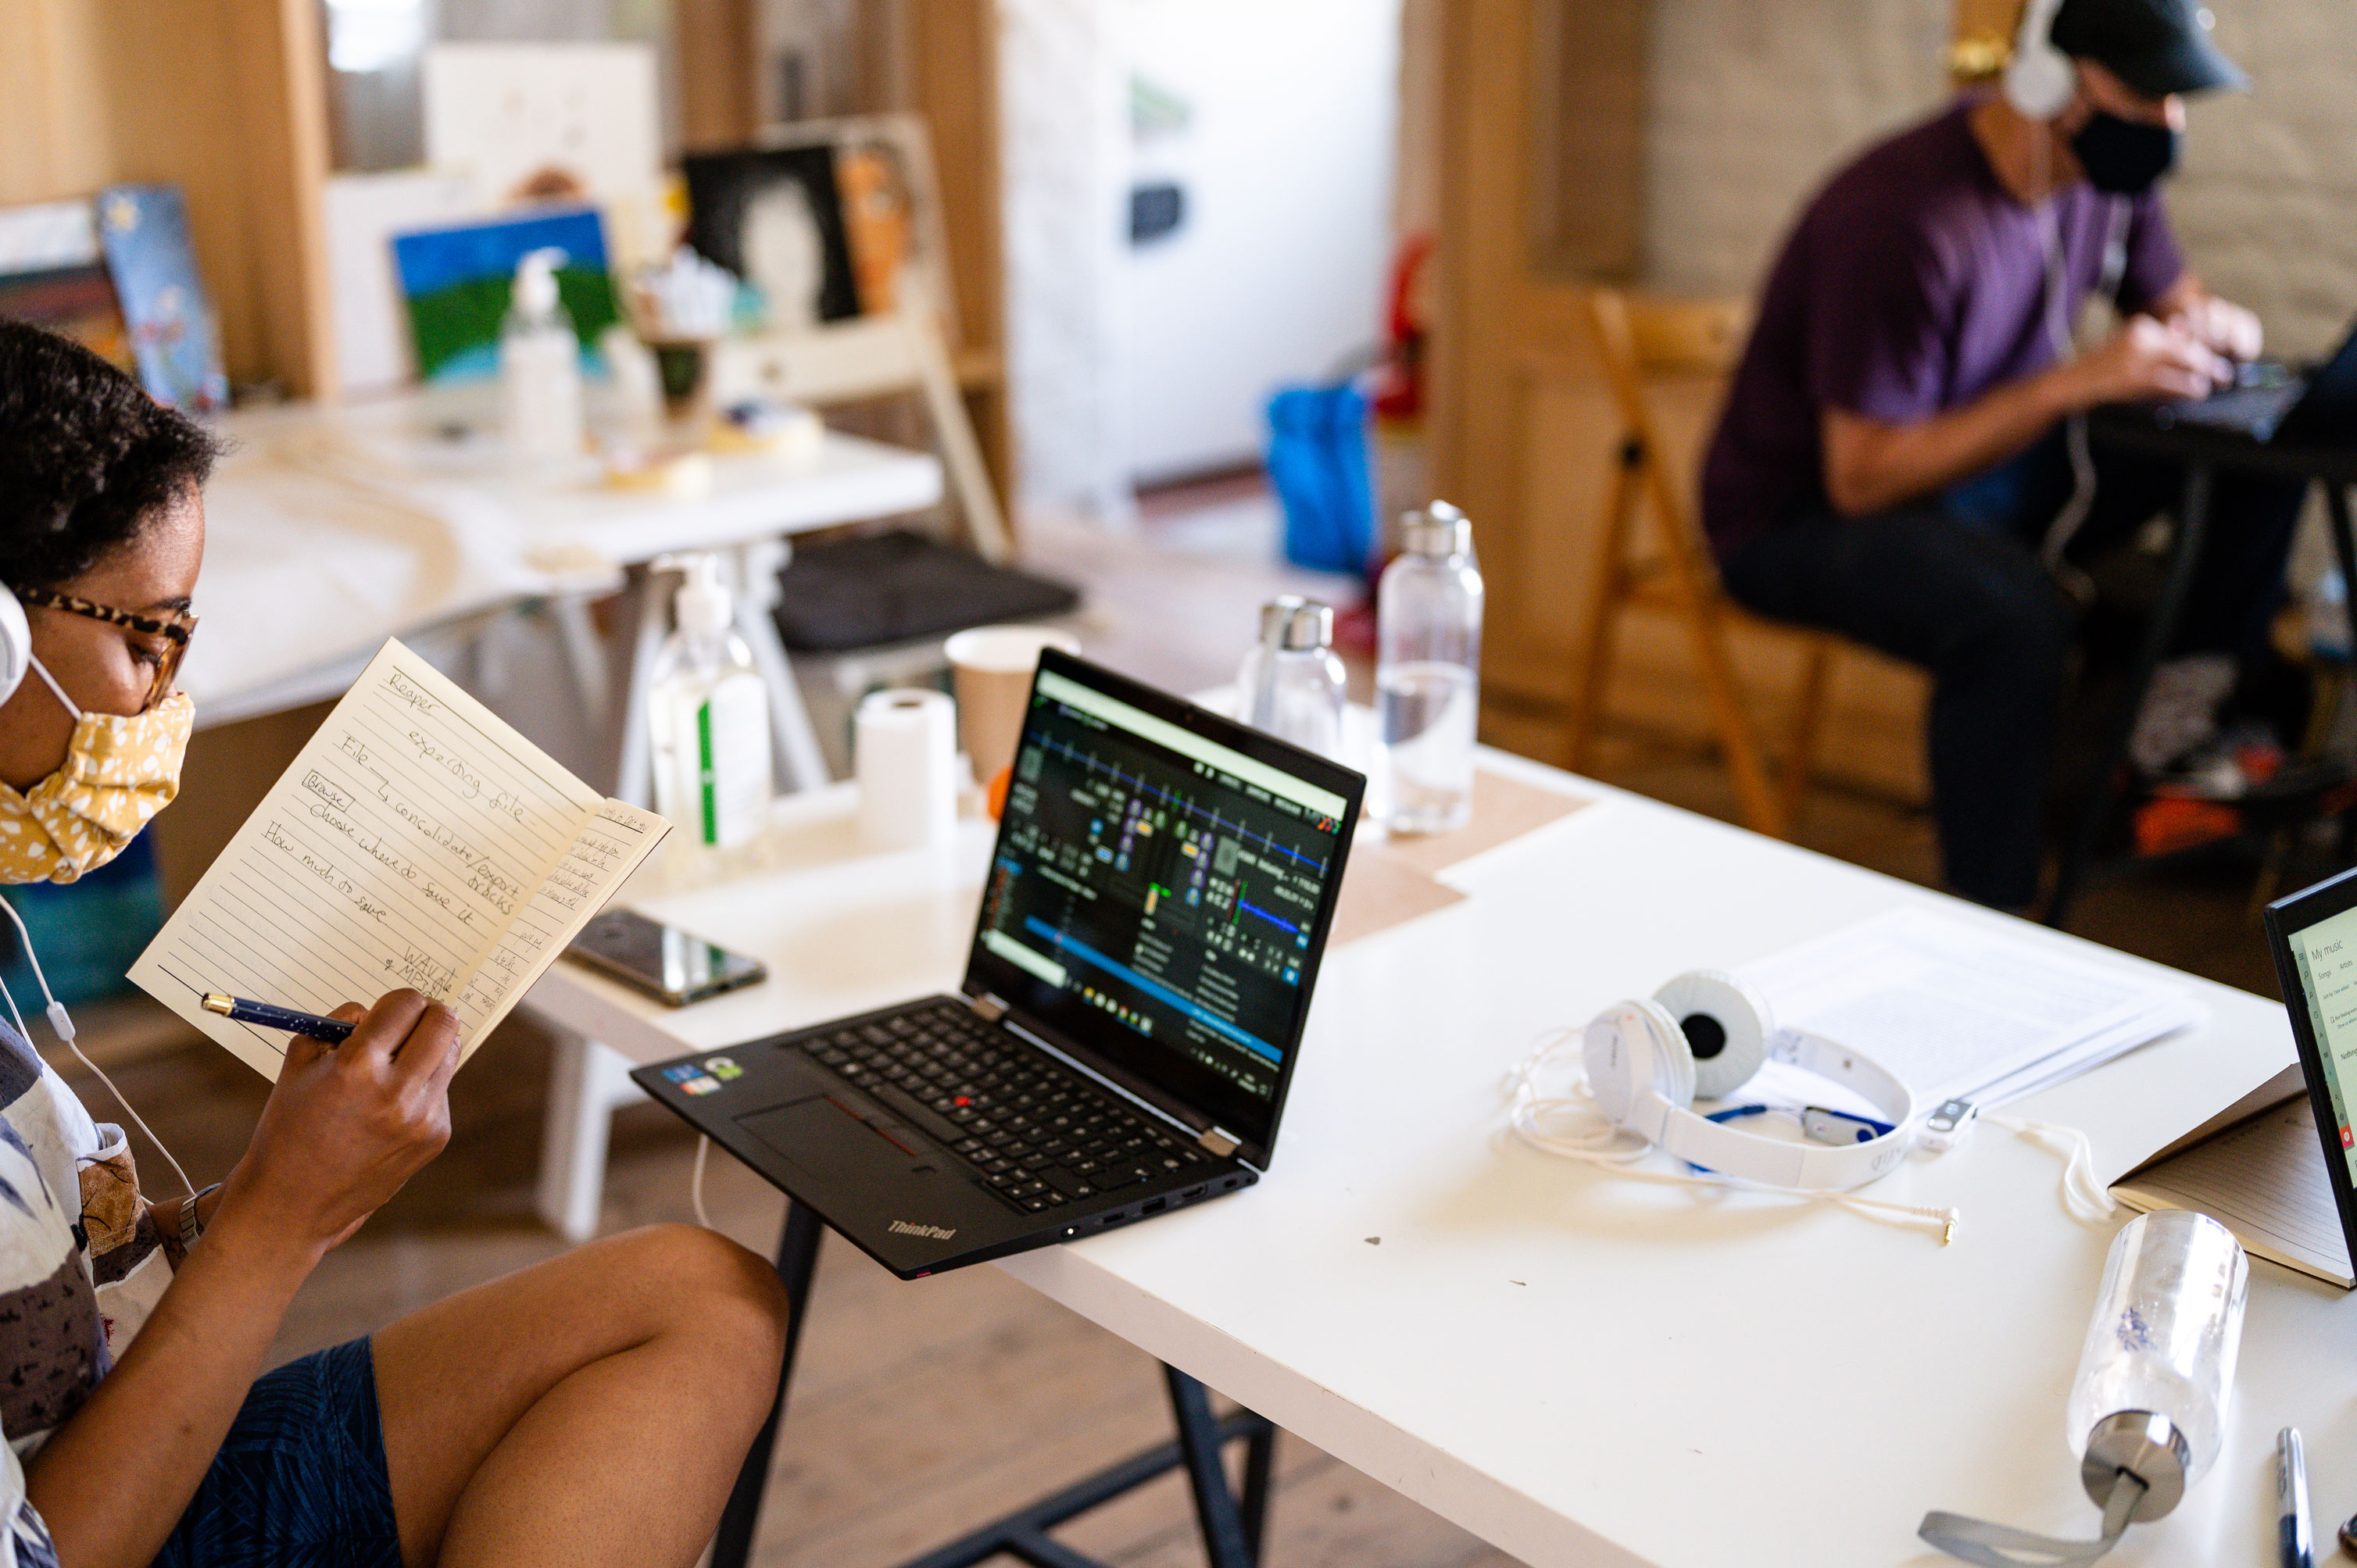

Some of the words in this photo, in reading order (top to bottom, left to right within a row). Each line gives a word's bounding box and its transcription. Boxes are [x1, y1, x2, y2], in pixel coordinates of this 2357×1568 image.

[389, 673, 440, 709] Reaper
[342, 735, 368, 766] File
[307, 773, 346, 807] Browse
[488, 791, 524, 823] file
[264, 820, 294, 852] How
[302, 853, 334, 884] much
[421, 881, 450, 909] save
[458, 904, 474, 927] it
[404, 945, 439, 977] WAV
[2311, 948, 2323, 962] My
[2323, 939, 2344, 955] music
[2340, 960, 2353, 970] Artists
[396, 965, 429, 991] MP3
[2318, 970, 2332, 980] Songs
[888, 1220, 957, 1241] ThinkPad
